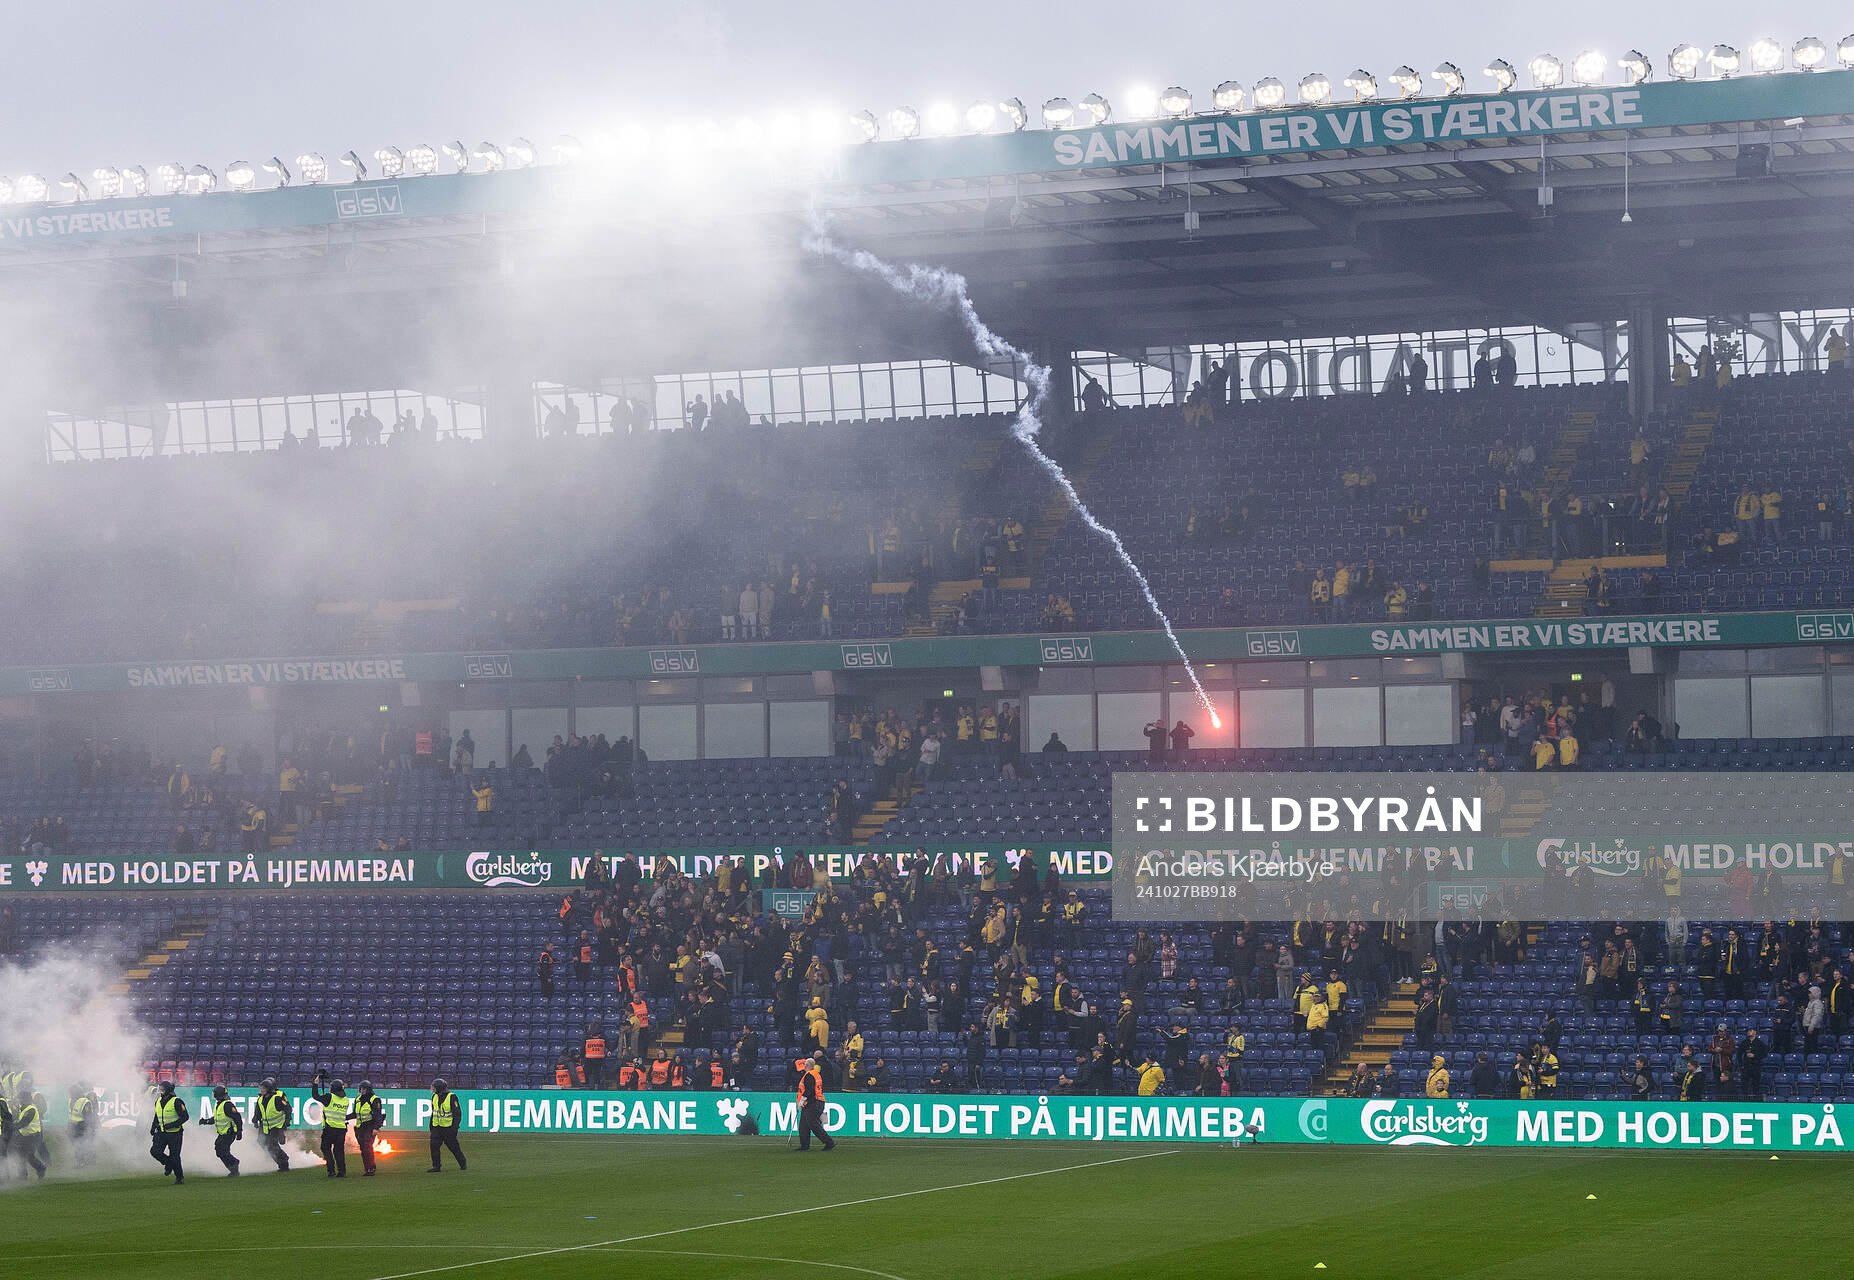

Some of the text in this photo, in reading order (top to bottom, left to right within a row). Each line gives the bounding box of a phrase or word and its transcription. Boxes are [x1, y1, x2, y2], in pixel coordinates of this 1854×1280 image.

[1053, 90, 1643, 166] SAMMEN ER VI STÆRKERE
[338, 194, 399, 216] GSV
[7, 217, 33, 238] VI
[36, 207, 174, 236] STÆRKERE
[1371, 620, 1721, 651] SAMMEN ER VI STÆRKERE
[1798, 620, 1853, 639] GSV
[843, 649, 890, 666] GSV
[1042, 644, 1091, 661] GSV
[1249, 637, 1298, 654] GSV
[127, 659, 407, 688] SAMMEN ER VI STÆRKERE
[465, 660, 510, 677] GSV
[652, 655, 696, 672] GSV
[62, 862, 116, 885] MED
[123, 861, 222, 884] HOLDET
[228, 853, 260, 883] PÅ
[465, 851, 552, 887] Carlsberg
[1049, 850, 1113, 876] MED
[1664, 843, 1735, 870] MED
[468, 1099, 698, 1133] HJEMMEBANE
[769, 1101, 847, 1132] MD
[858, 1102, 1000, 1135] HOLDET
[1010, 1095, 1057, 1136] PÅ
[1360, 1099, 1489, 1147] Carlsberg
[1516, 1103, 1845, 1147] MED HOLDET PÅ
